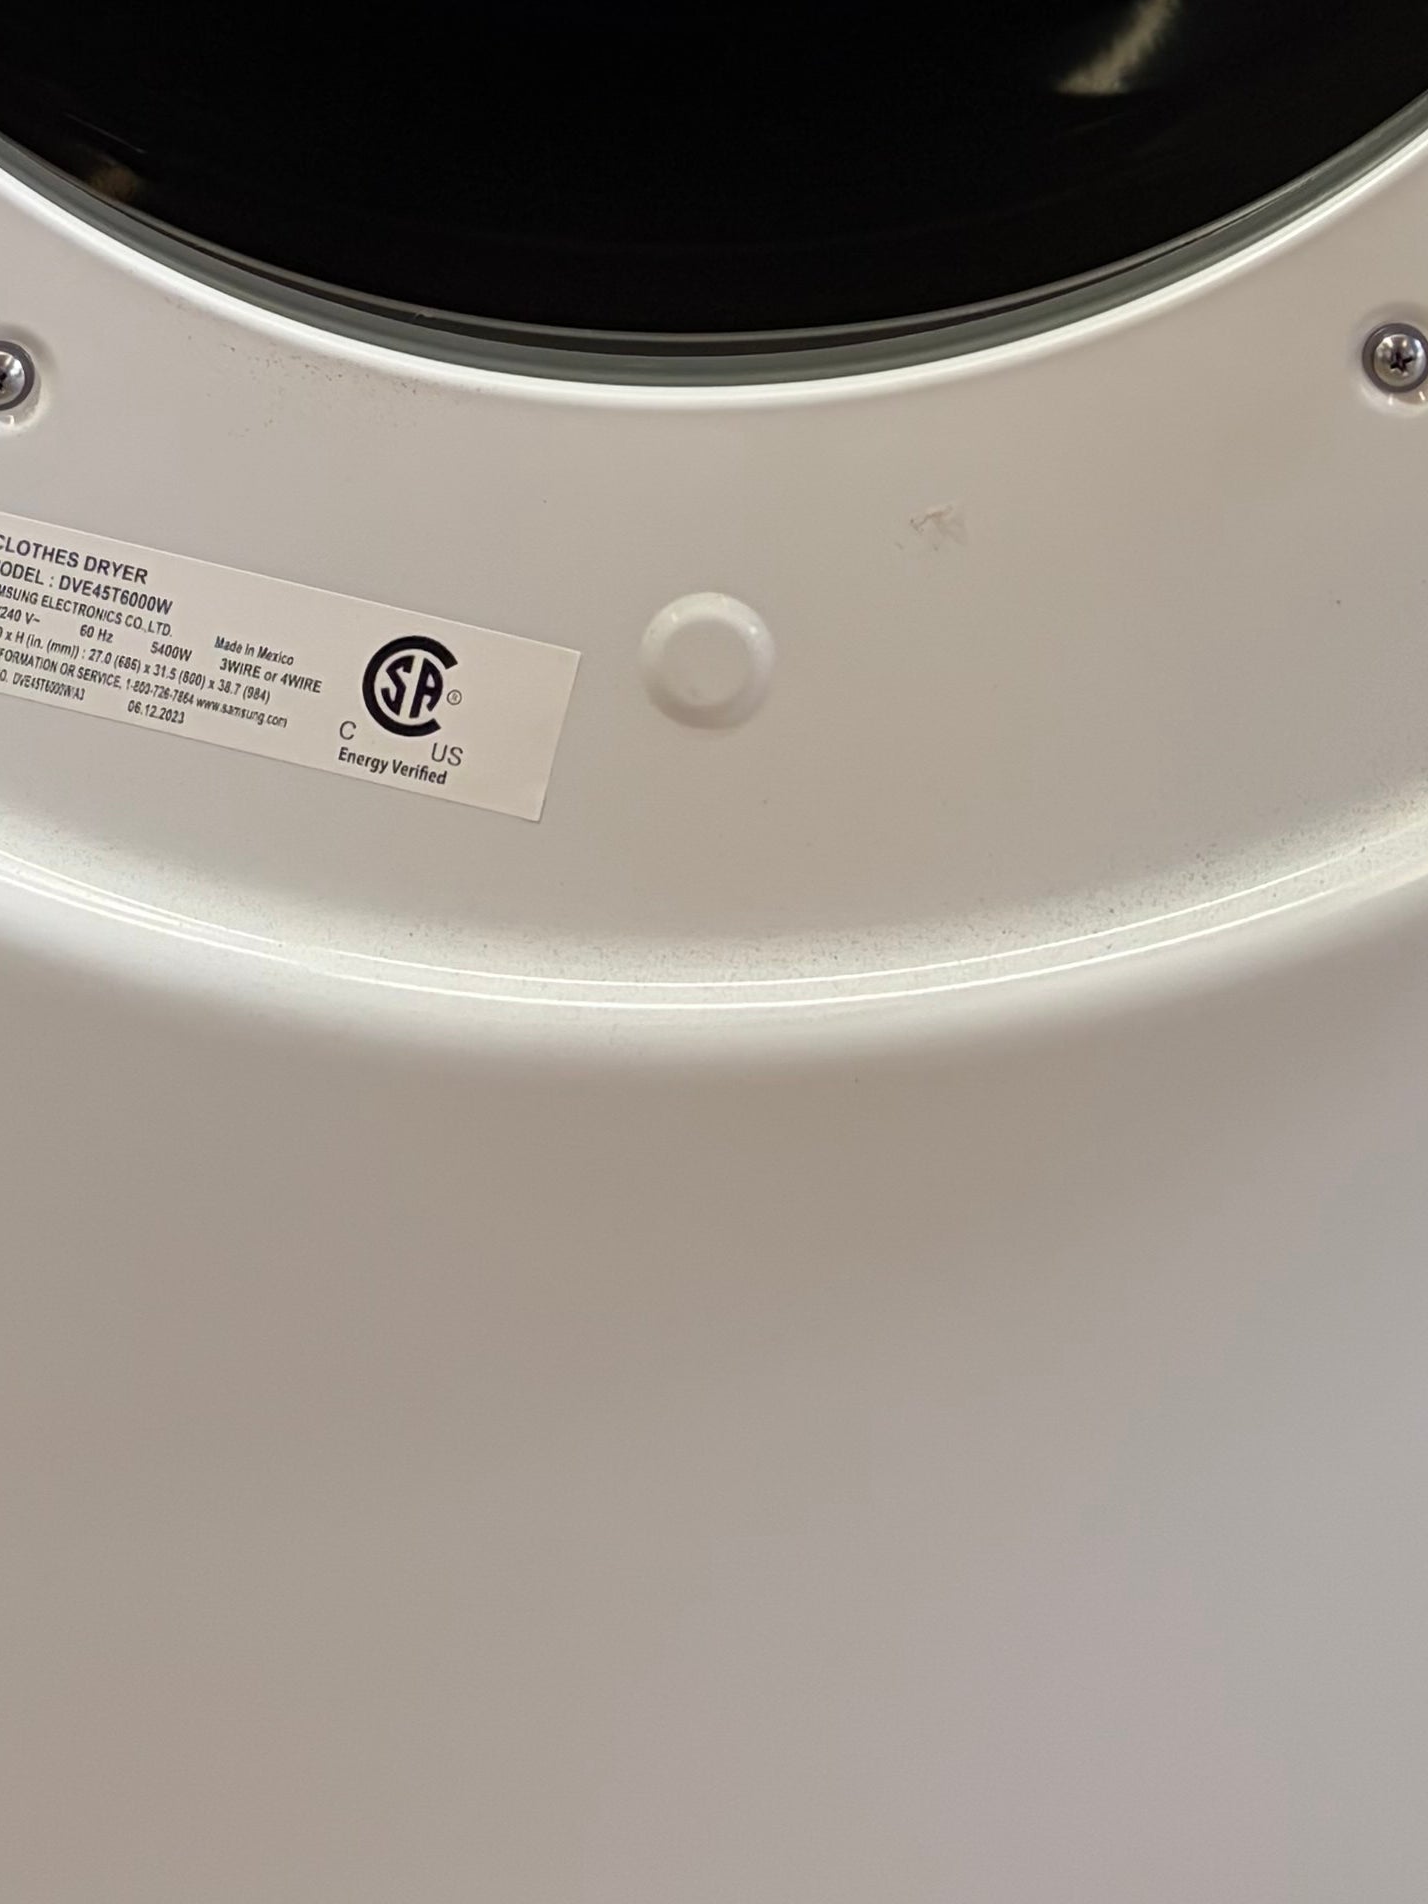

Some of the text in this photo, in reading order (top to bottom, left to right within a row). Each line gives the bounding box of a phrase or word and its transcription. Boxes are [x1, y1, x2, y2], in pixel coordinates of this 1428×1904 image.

[84, 556, 148, 584] DRYER
[41, 596, 122, 624] ELECTRONICS
[58, 575, 173, 615] DVE45T6000W
[15, 632, 24, 644] H
[88, 648, 112, 665] 27.0
[153, 664, 176, 680] 31.5
[218, 679, 241, 695] 38.7
[59, 663, 76, 677] OR
[79, 625, 94, 638] 60
[97, 629, 114, 643] Hz
[150, 641, 192, 662] 5400W
[219, 658, 262, 679] 3WIRE
[263, 670, 278, 682] or
[280, 672, 323, 693] 4WIRE
[214, 636, 243, 653] Made
[257, 646, 295, 666] Mexico
[339, 720, 463, 767] C US
[338, 746, 447, 785] Energy Verified
